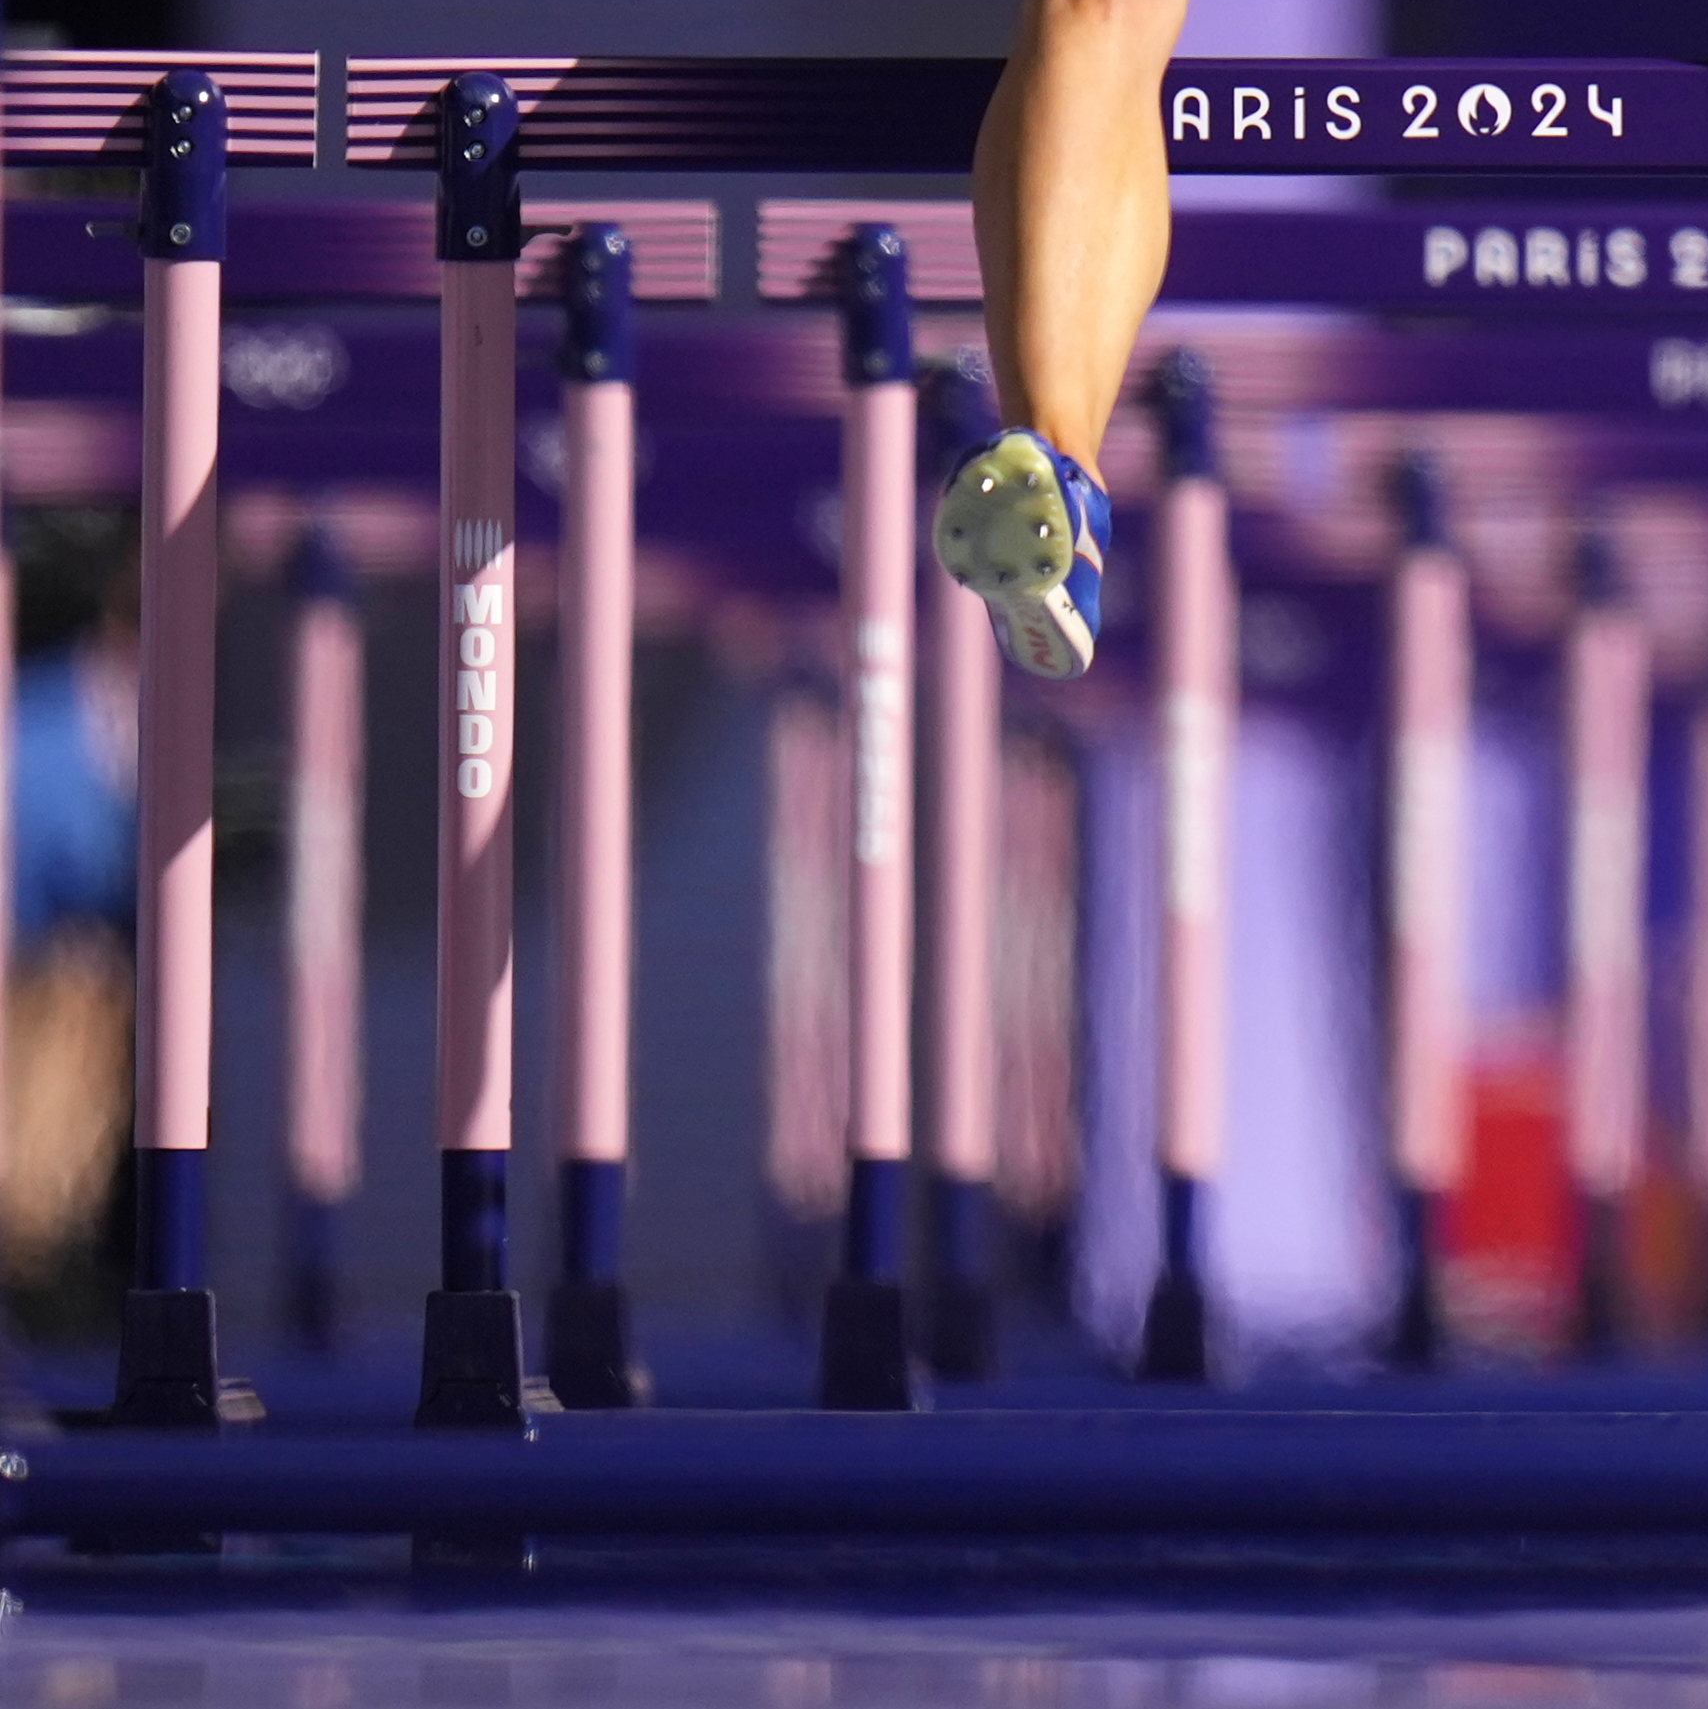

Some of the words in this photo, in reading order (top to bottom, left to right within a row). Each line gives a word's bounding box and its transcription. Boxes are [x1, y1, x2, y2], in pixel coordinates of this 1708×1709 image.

[1172, 86, 1362, 140] ARiS
[1401, 83, 1624, 138] 2024
[454, 584, 502, 798] MONDO
